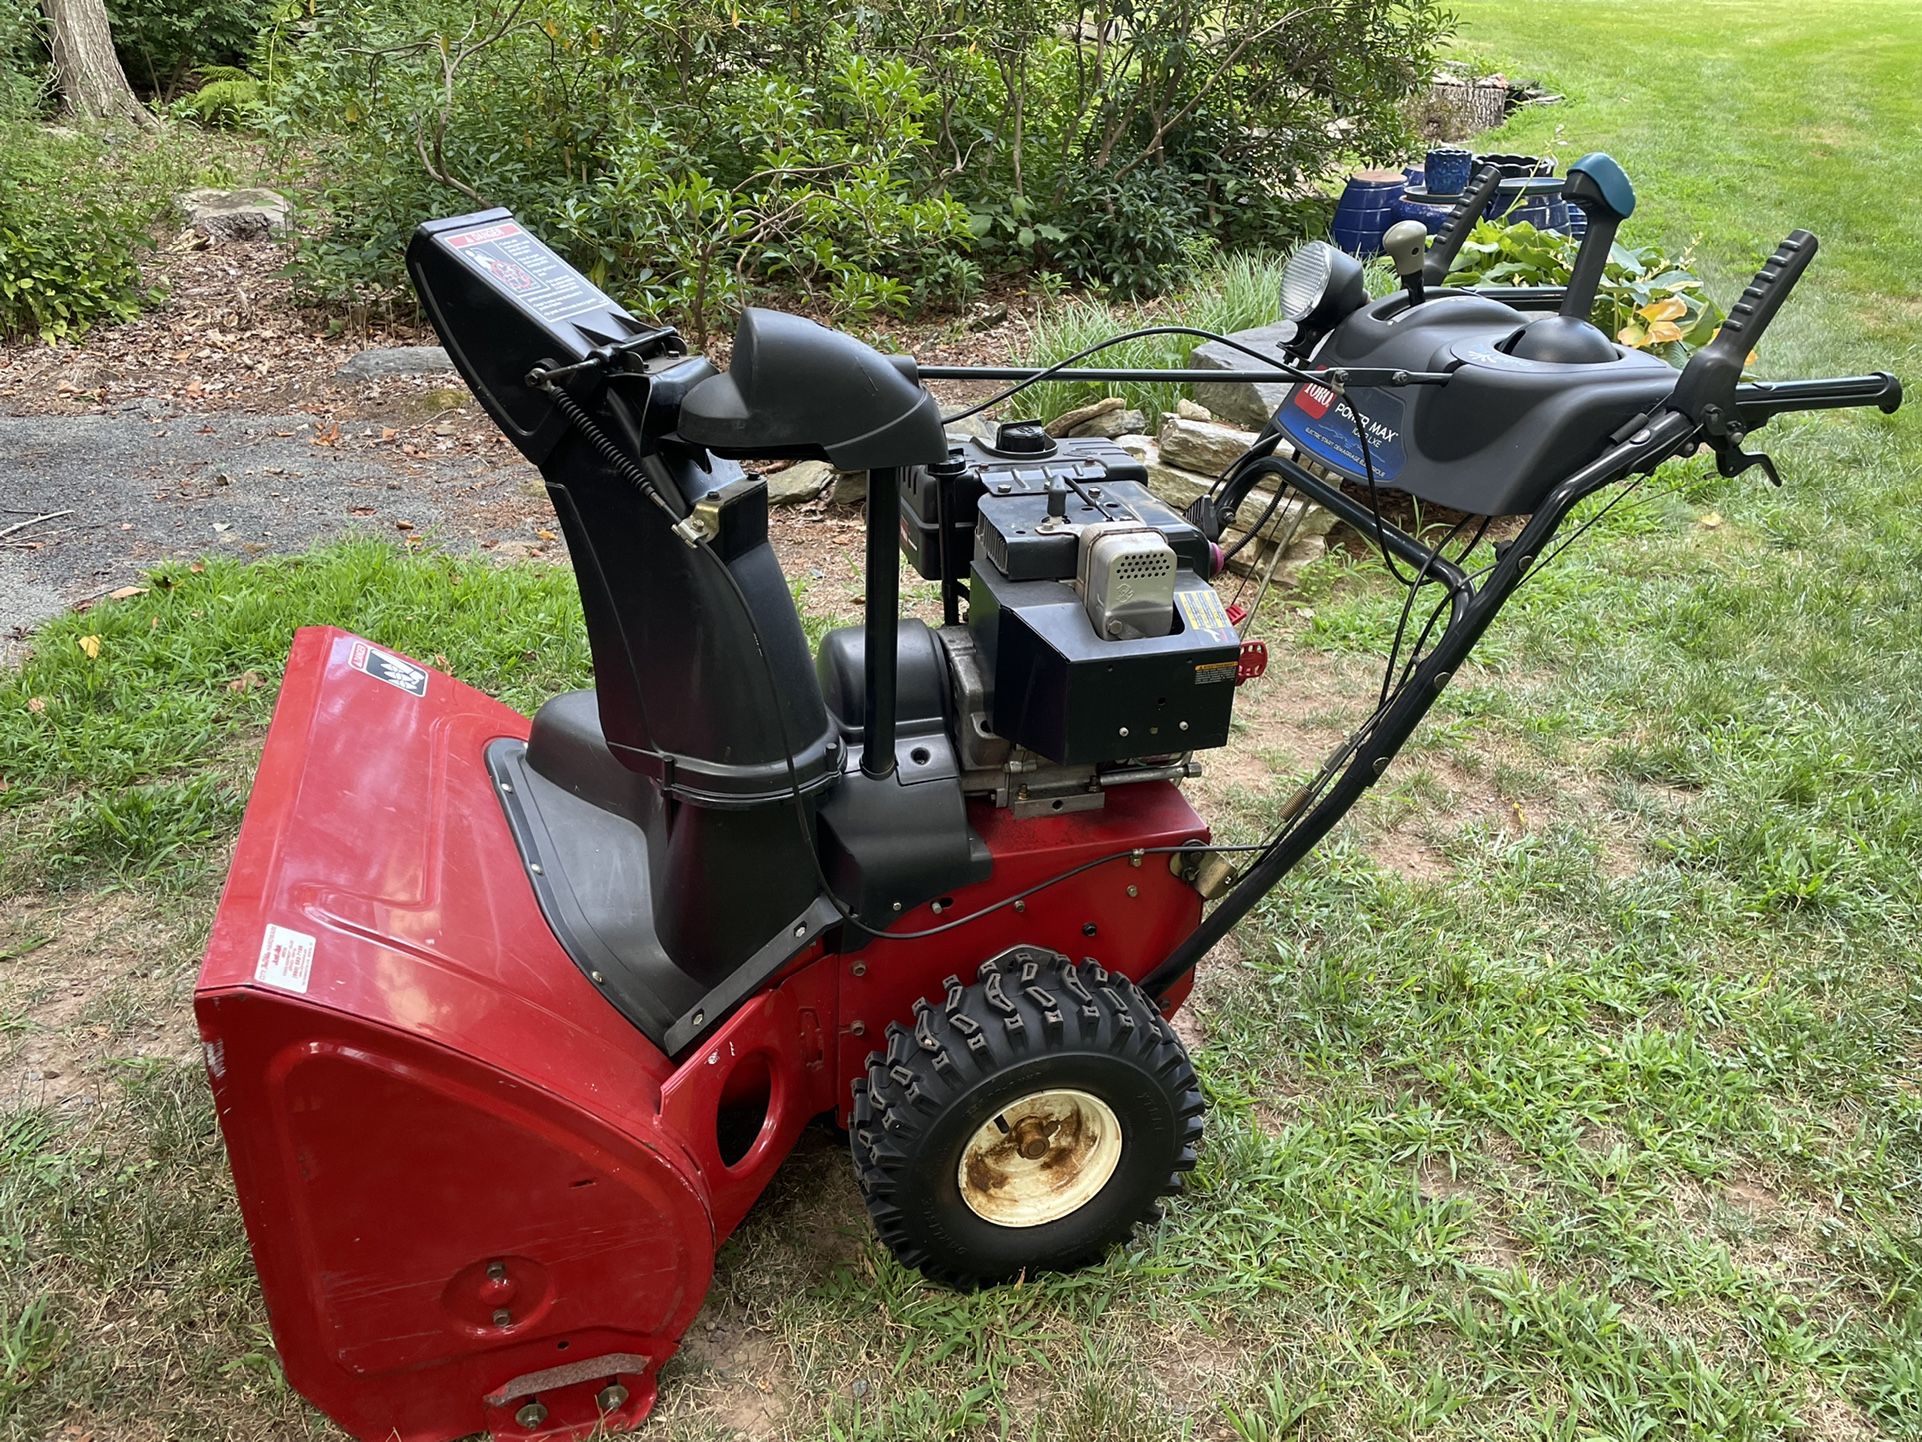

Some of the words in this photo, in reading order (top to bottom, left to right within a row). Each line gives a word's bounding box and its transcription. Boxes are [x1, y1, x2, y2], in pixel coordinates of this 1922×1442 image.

[1334, 402, 1370, 428] POWR
[1368, 421, 1398, 442] MAX
[1368, 436, 1382, 448] LXE
